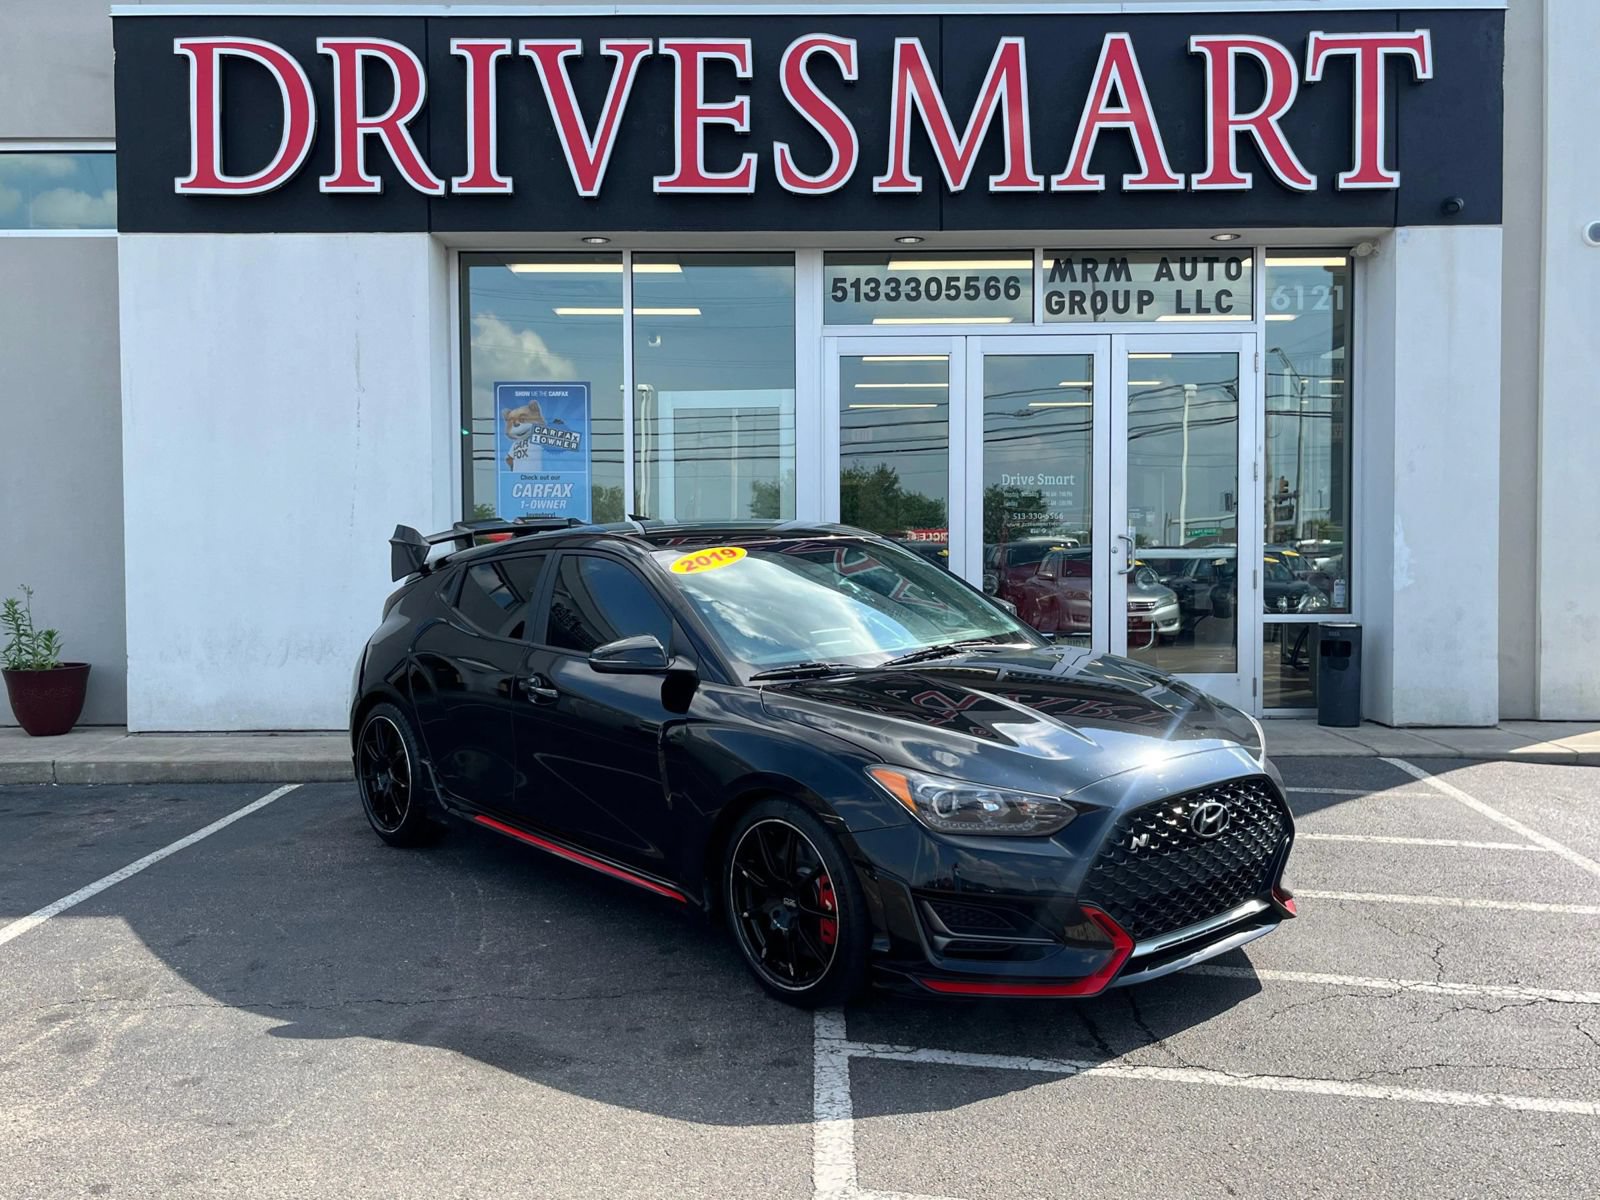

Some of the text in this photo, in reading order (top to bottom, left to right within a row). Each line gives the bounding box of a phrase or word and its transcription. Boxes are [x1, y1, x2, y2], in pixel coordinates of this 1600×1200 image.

[173, 28, 1434, 196] DRIVESMART
[1048, 256, 1243, 283] MRM AUTO
[831, 276, 1021, 303] 5133305566
[1270, 285, 1344, 311] 6121
[1045, 289, 1234, 316] GROUP LLC
[534, 426, 580, 442] CARFAX
[540, 437, 577, 450] OWNER
[513, 449, 529, 459] FOX
[1001, 473, 1076, 486] Drive Smart
[512, 483, 575, 498] CARFAX
[520, 500, 567, 510] 1-OWNER
[680, 548, 737, 573] 2019
